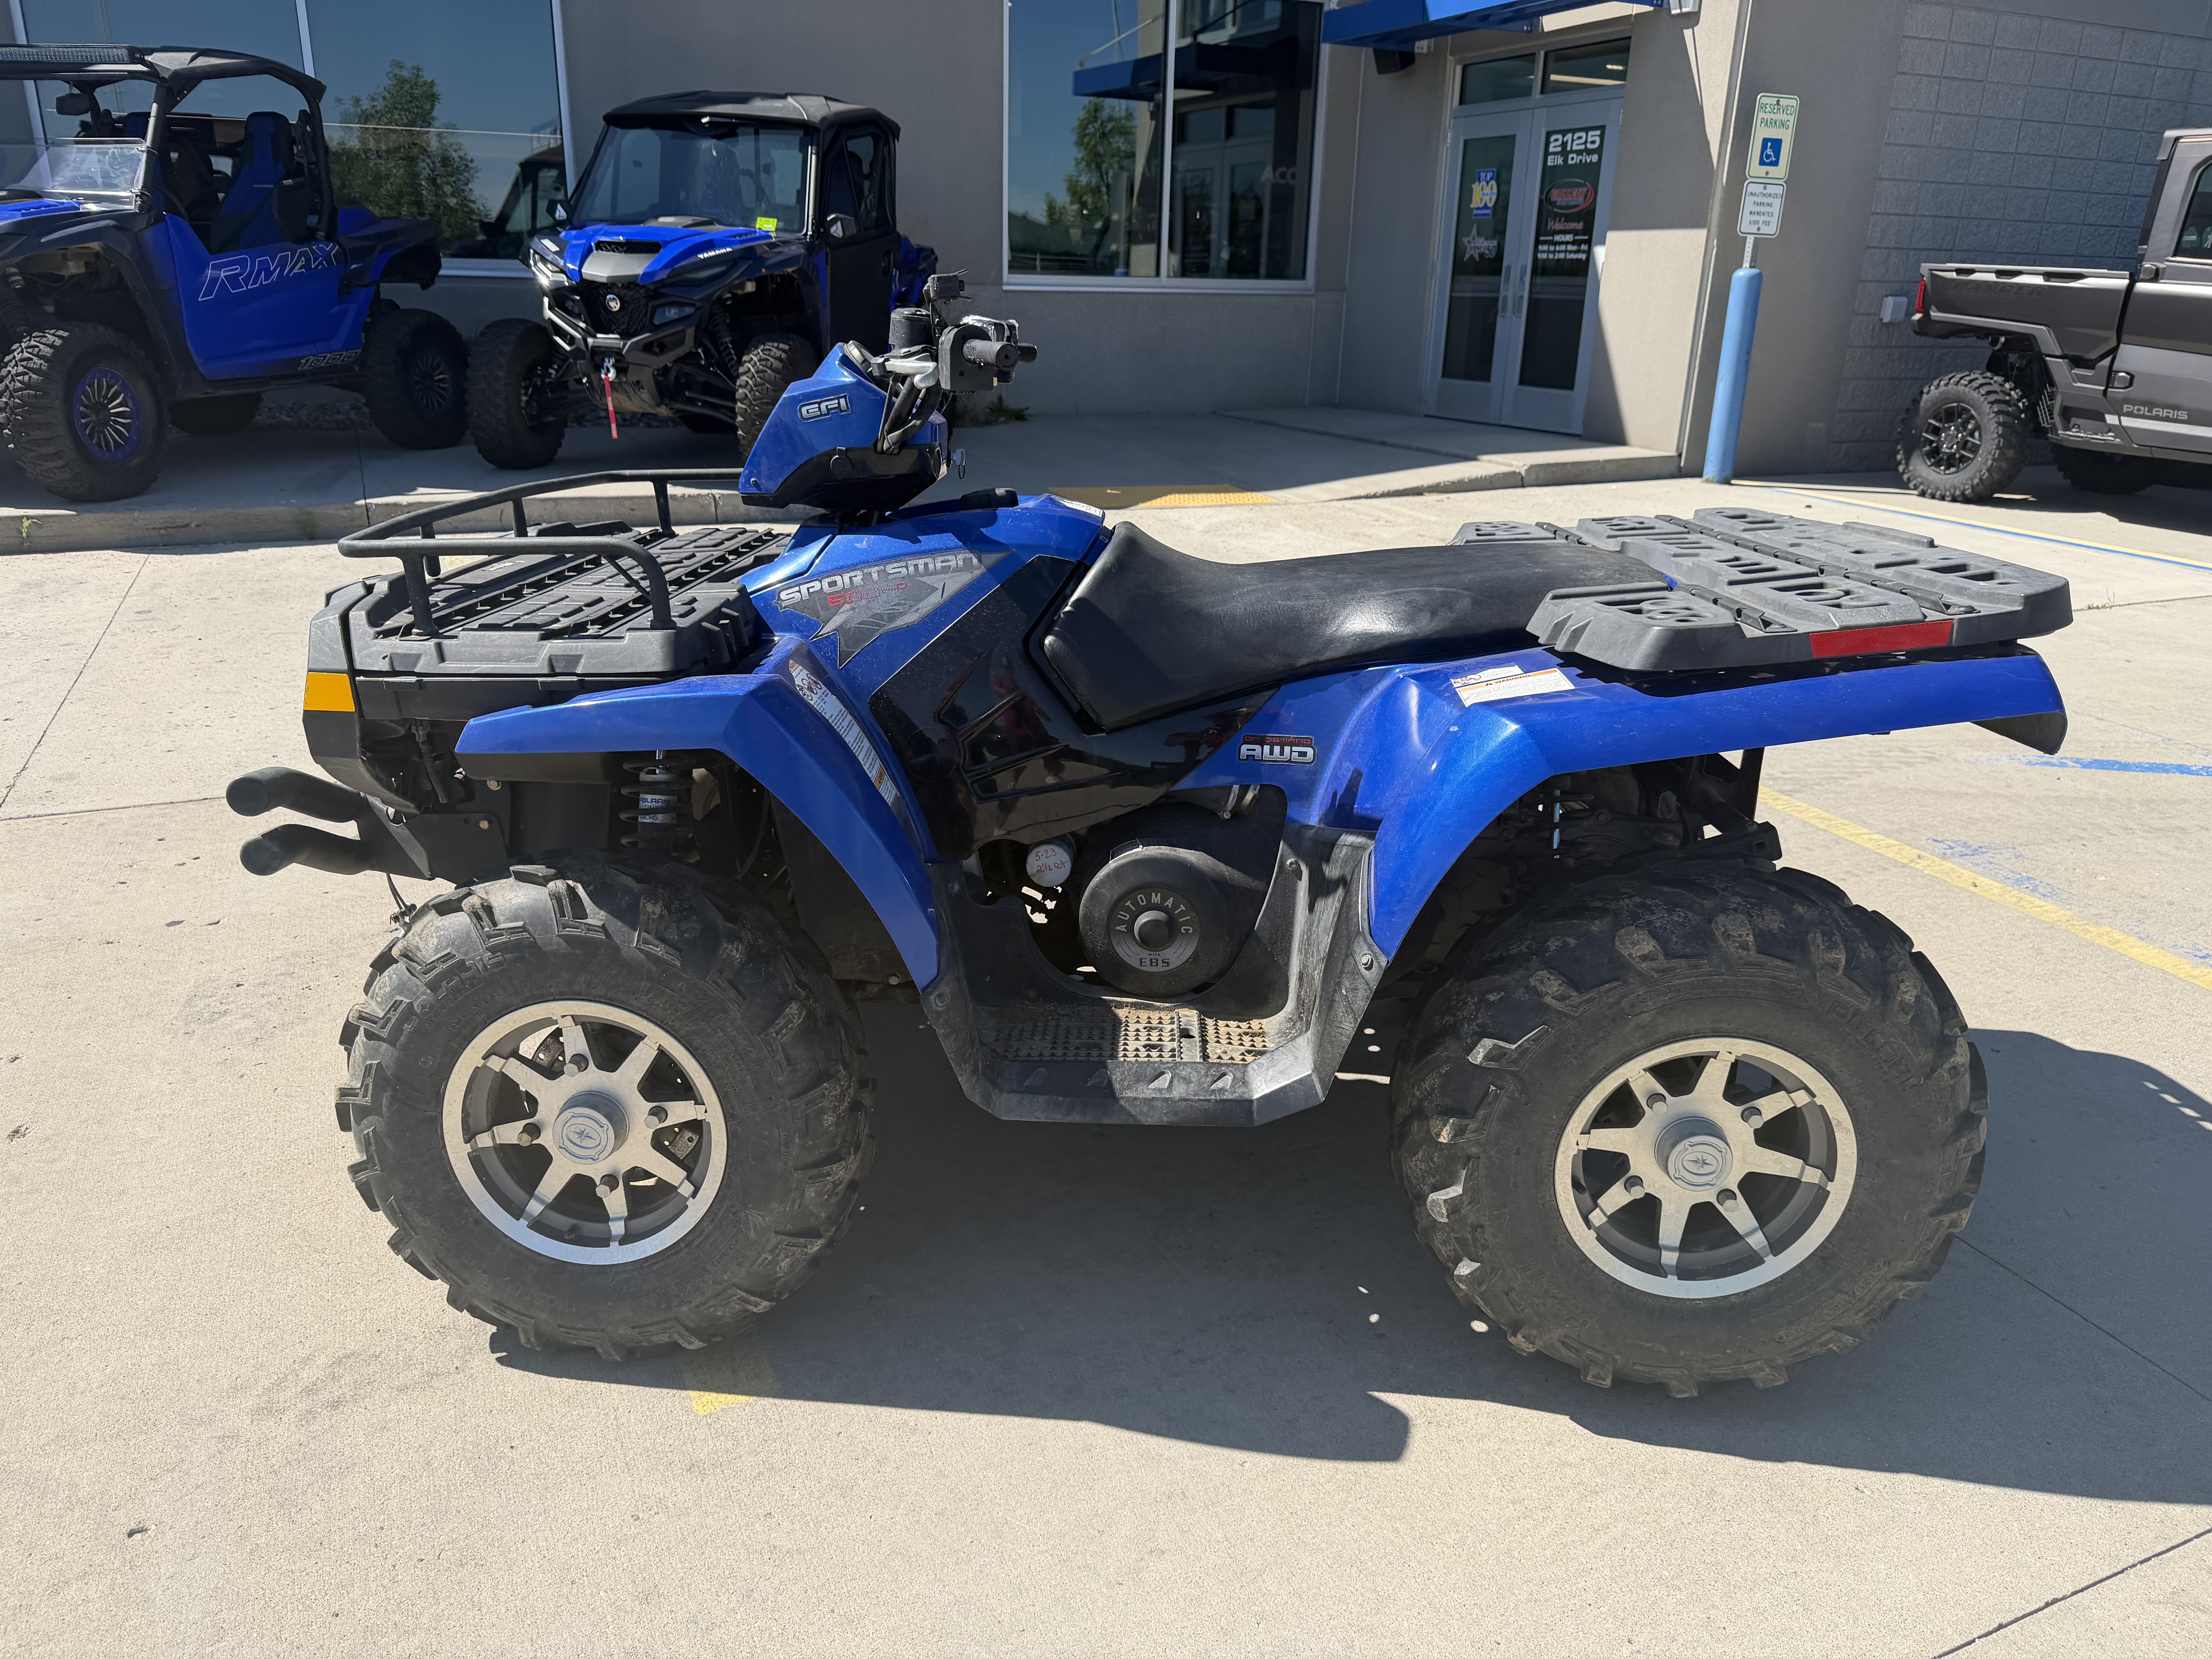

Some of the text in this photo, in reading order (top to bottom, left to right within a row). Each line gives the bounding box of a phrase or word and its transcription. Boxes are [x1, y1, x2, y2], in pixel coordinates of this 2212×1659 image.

[1760, 103, 1795, 115] RESERVED
[1760, 117, 1790, 130] PARKING
[1549, 130, 1601, 152] 2125
[1547, 152, 1599, 166] Elk Drive
[1479, 172, 1493, 181] TOP
[1470, 181, 1498, 208] 100
[1547, 217, 1584, 230] Welcome
[1554, 234, 1574, 242] HOURS
[697, 247, 733, 259] YAMAHA
[1566, 252, 1587, 261] Saturday
[198, 243, 339, 301] RMAX
[298, 349, 361, 371] 1000
[801, 398, 847, 418] EFI
[2123, 404, 2188, 420] POLARIS
[780, 553, 981, 607] SPORTSMAN
[1495, 674, 1531, 684] WARNING
[1240, 744, 1314, 762] AWD
[1035, 848, 1057, 861] 5-23
[1115, 892, 1193, 934] AUTOMATIC
[1140, 958, 1171, 967] EBS
